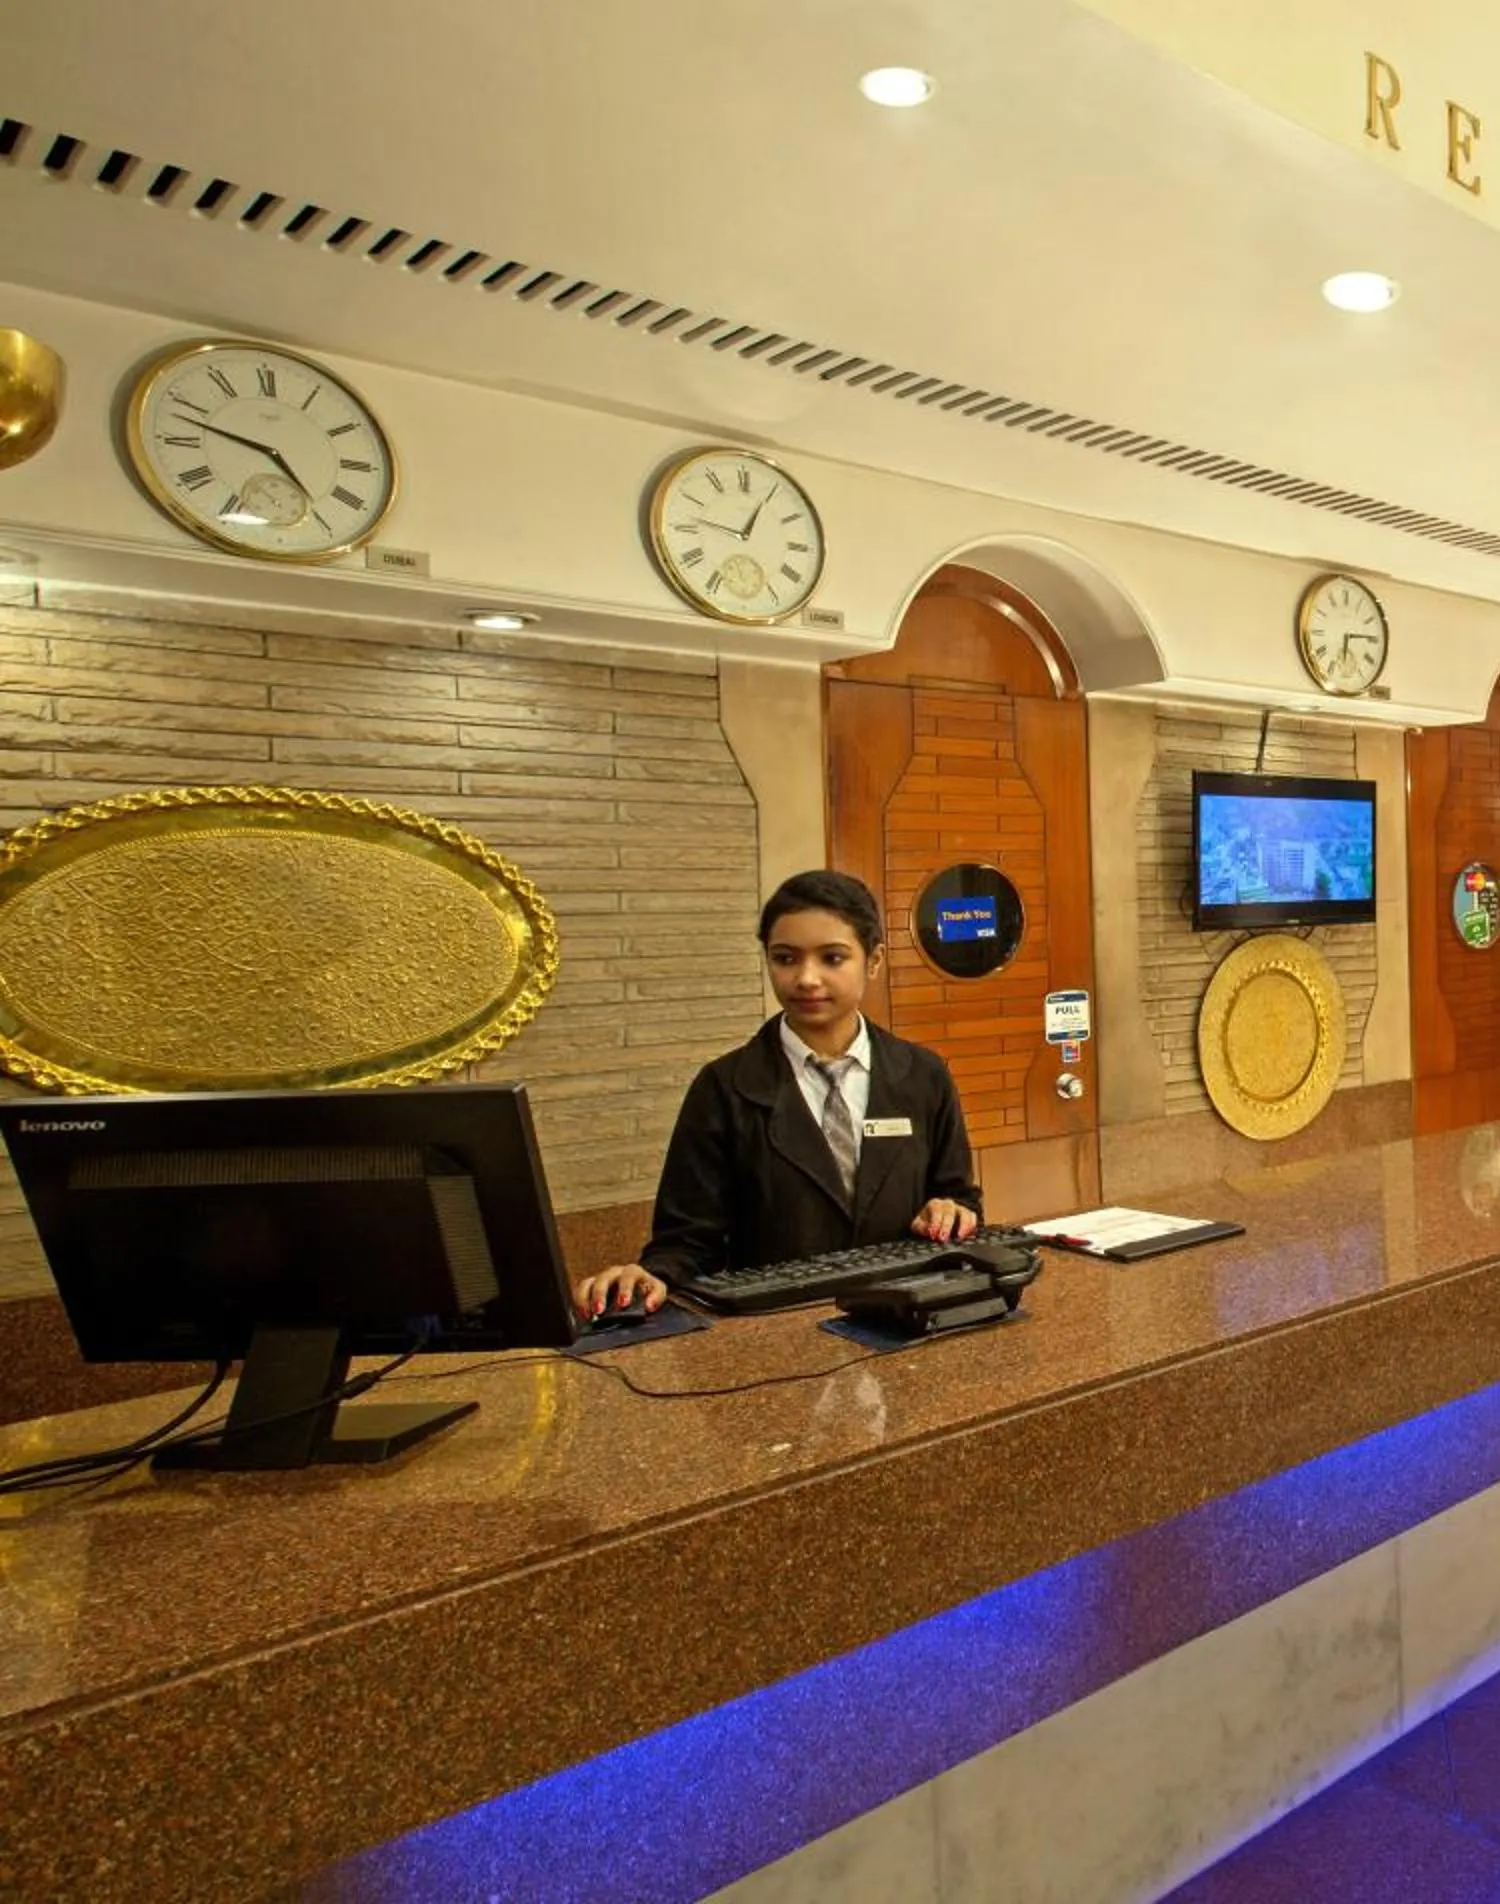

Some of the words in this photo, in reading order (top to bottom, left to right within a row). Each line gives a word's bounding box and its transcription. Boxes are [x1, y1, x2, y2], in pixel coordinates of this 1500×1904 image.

[942, 911, 972, 921] Thank
[973, 910, 993, 920] You
[1055, 1005, 1081, 1016] PULL
[20, 1119, 106, 1132] lenovo
